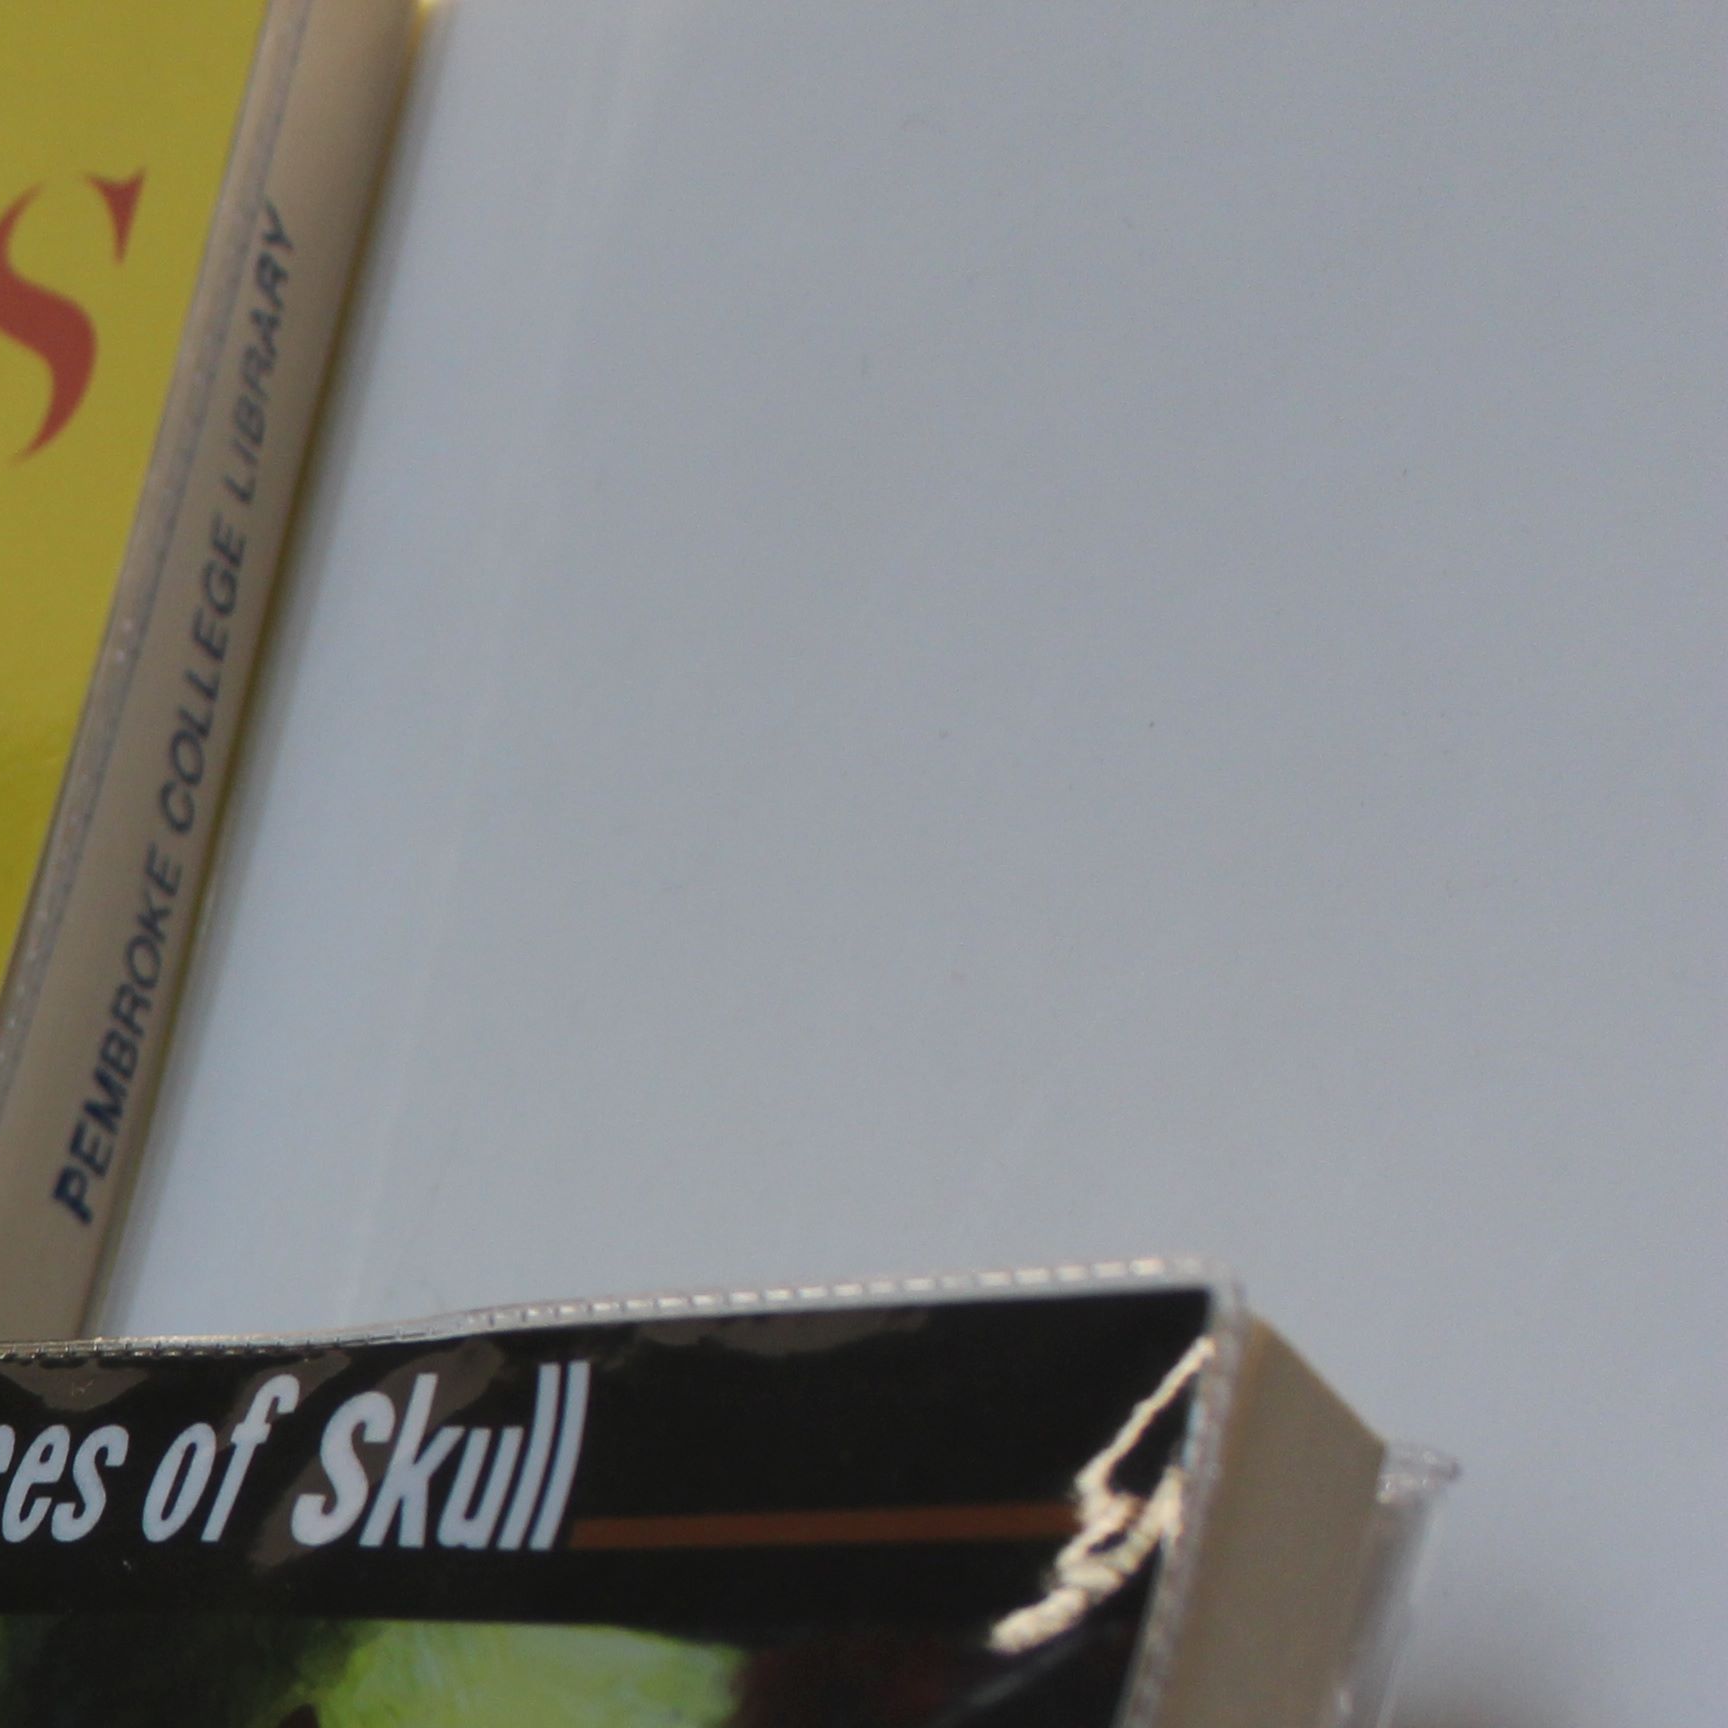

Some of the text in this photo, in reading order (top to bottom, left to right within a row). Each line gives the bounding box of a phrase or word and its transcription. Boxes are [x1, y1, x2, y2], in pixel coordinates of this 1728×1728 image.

[53, 202, 297, 1226] PEMBROKE COLLEGE LIBRARY
[143, 1373, 301, 1543] of
[290, 1360, 590, 1550] Skull
